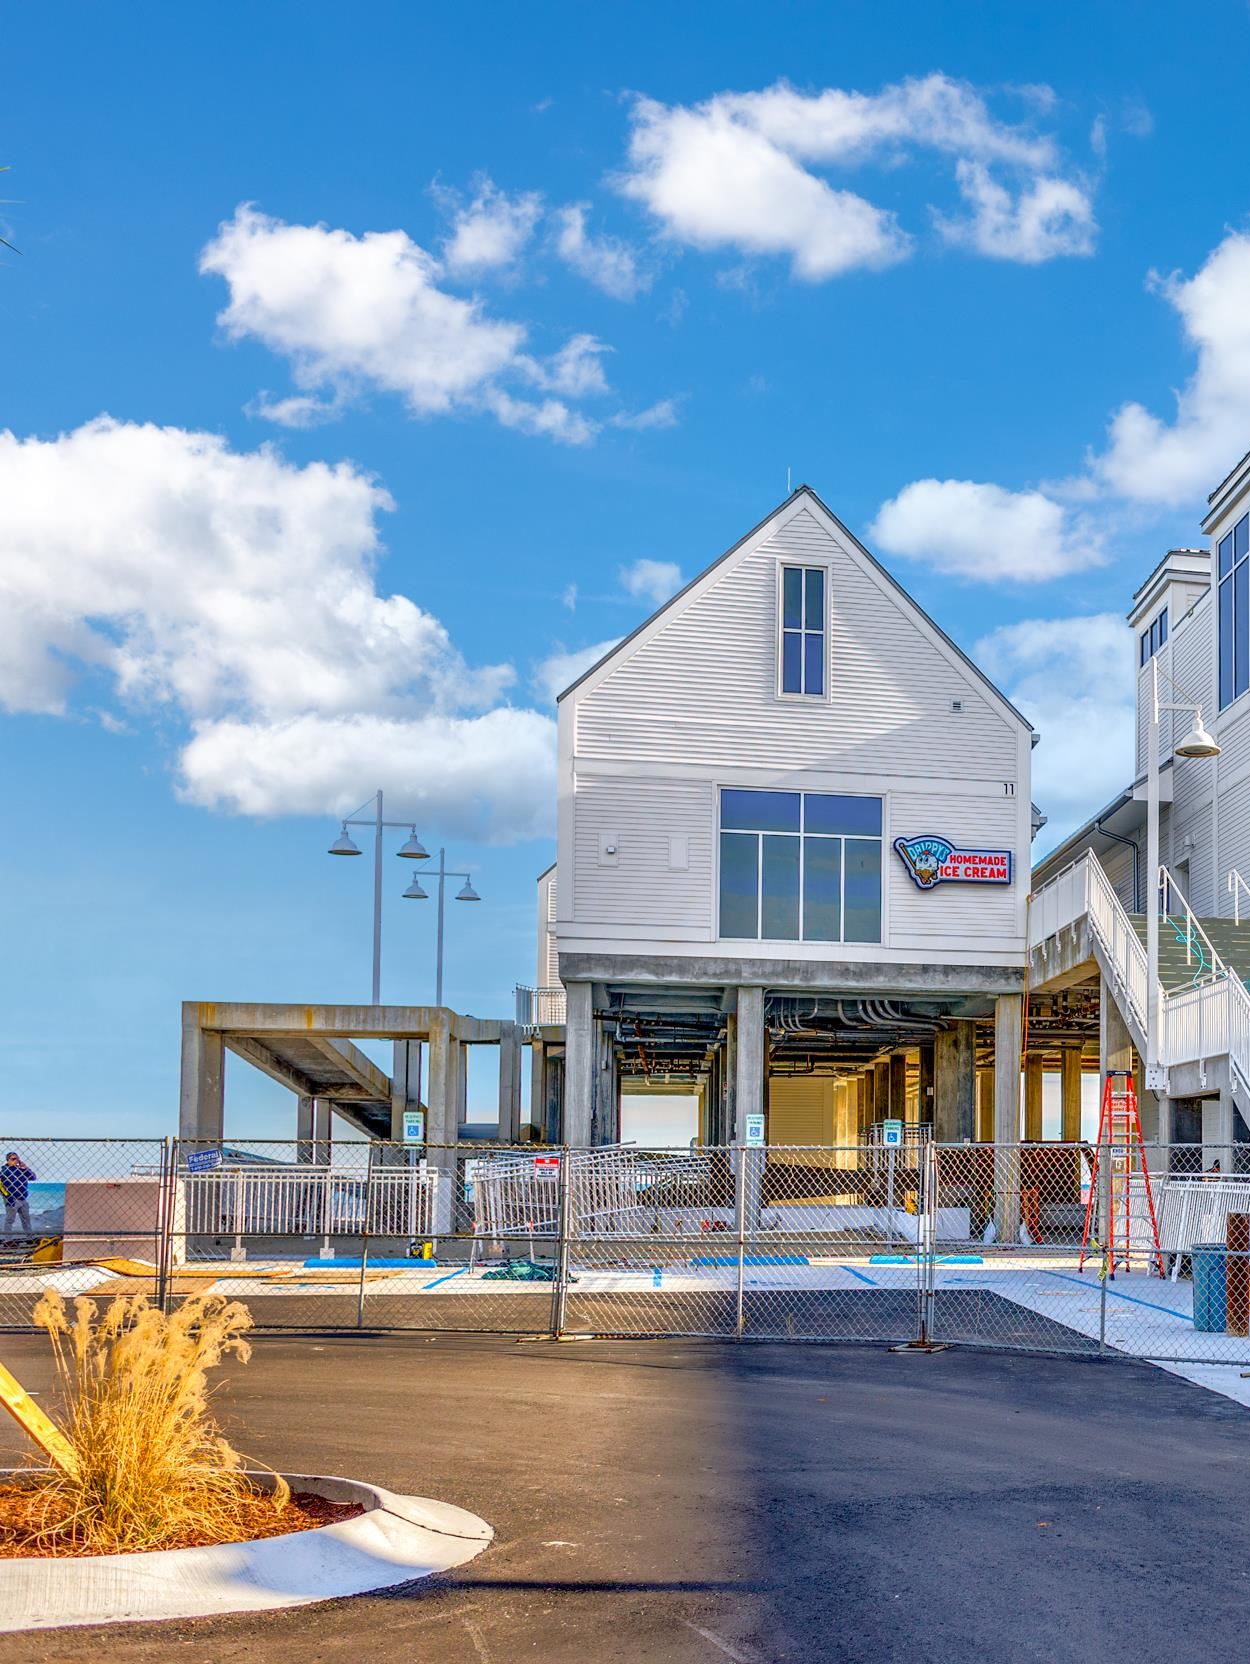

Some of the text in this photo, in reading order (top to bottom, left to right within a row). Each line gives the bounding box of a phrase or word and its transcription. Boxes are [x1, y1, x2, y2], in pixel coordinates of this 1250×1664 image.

[1003, 783, 1014, 795] 11
[907, 841, 950, 860] DRIPPY'S
[949, 854, 1007, 866] HOMEMADE
[939, 865, 1007, 878] ICE CREAM
[188, 1150, 219, 1164] Federal
